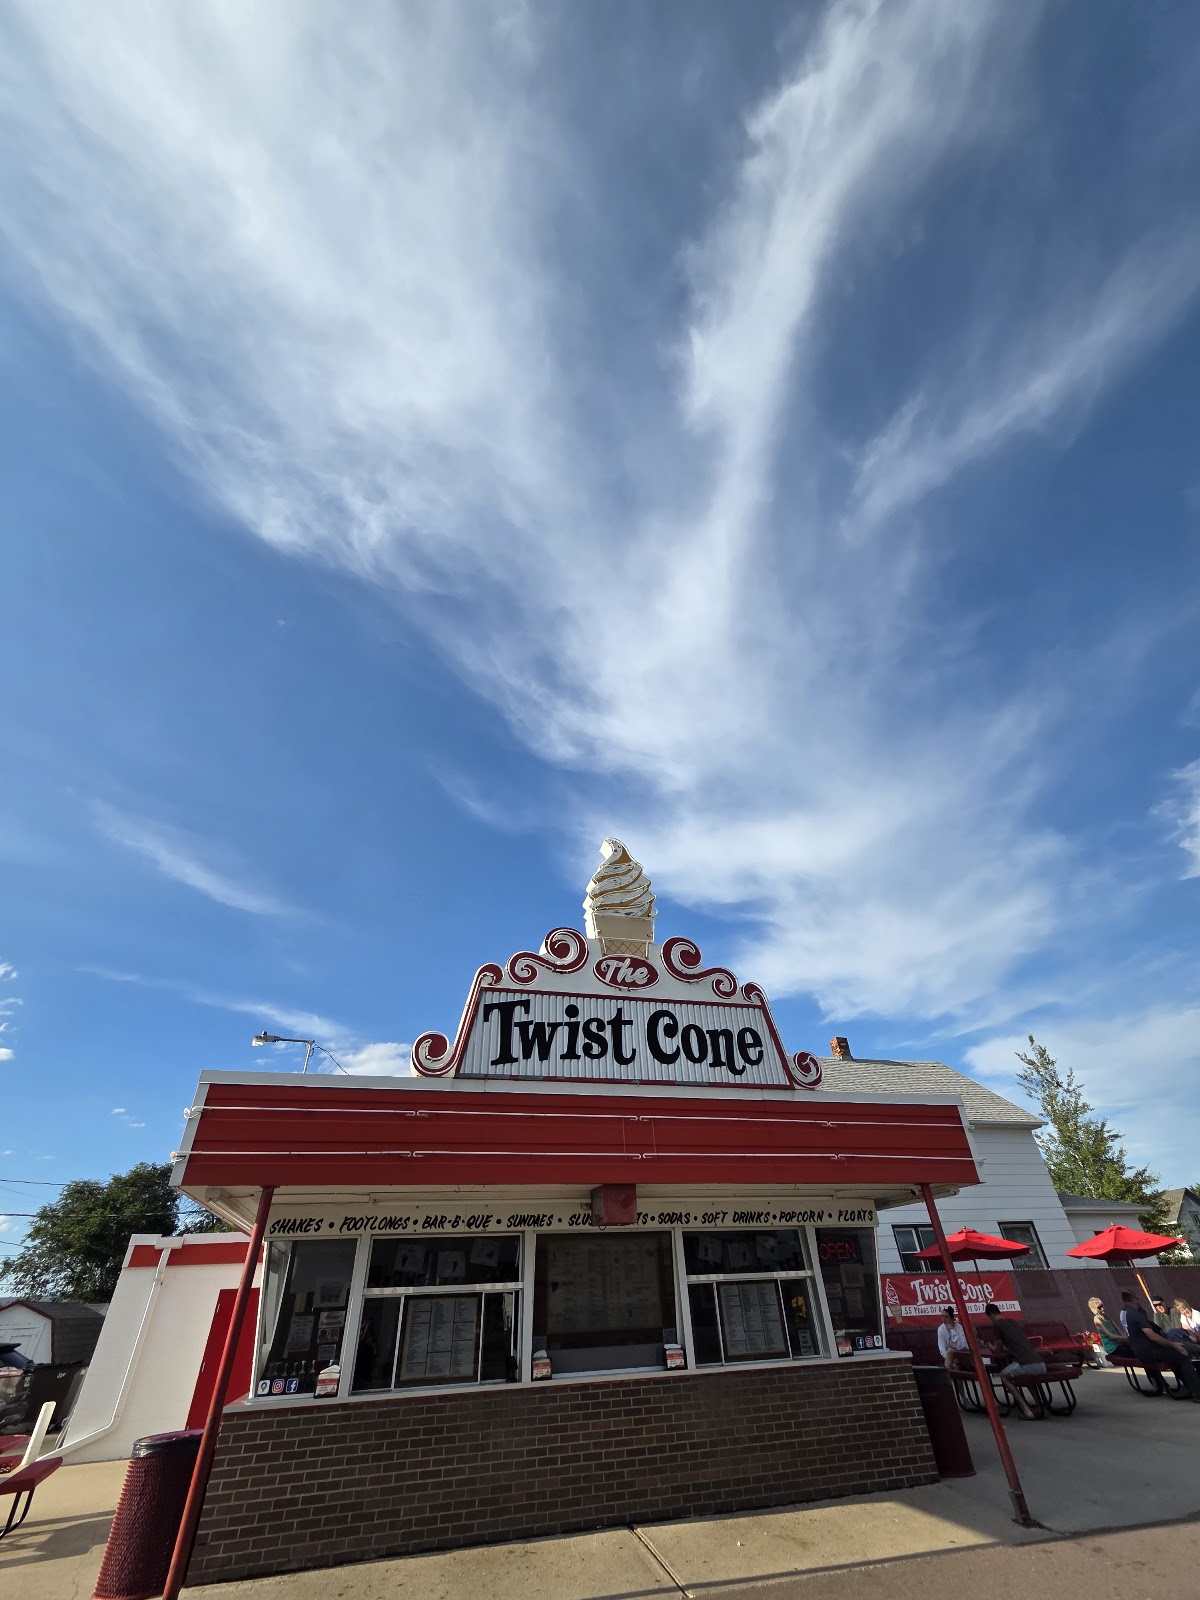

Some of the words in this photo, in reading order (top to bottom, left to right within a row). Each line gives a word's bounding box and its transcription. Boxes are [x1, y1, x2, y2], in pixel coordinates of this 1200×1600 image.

[600, 957, 650, 984] The
[483, 999, 636, 1067] Twist
[647, 1009, 764, 1075] Cone
[269, 1217, 324, 1234] SHAKES
[339, 1215, 411, 1233] FOOTLONGS
[506, 1213, 554, 1229] SUNDAES
[657, 1211, 691, 1225] SODAS
[701, 1210, 729, 1224] SOFT
[732, 1210, 771, 1224] DRINKS
[779, 1209, 825, 1223] POPCORN
[837, 1208, 874, 1222] FLOATS
[820, 1243, 857, 1260] OPEN
[910, 1279, 956, 1306] Twist
[904, 1306, 913, 1315] 55
